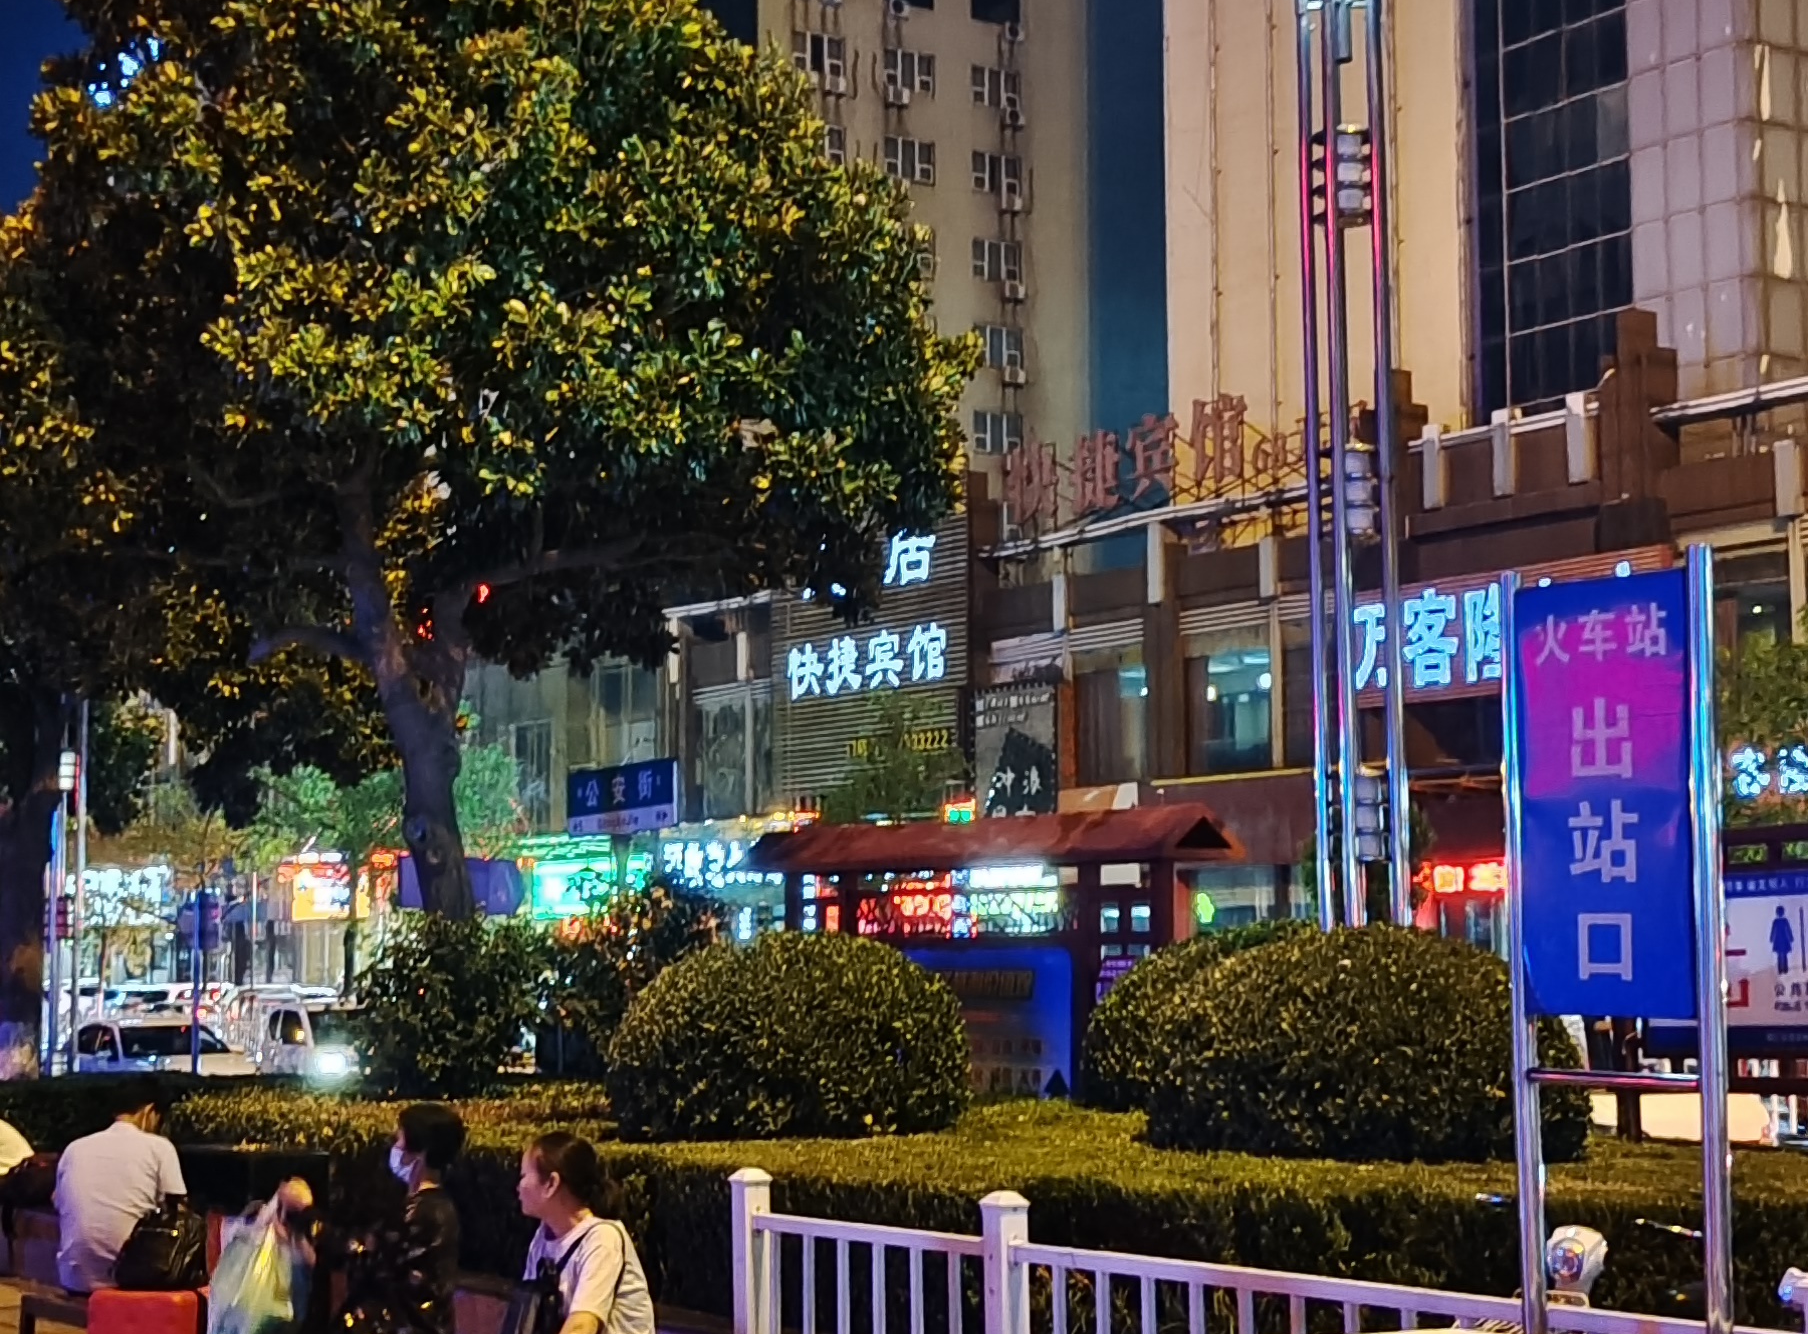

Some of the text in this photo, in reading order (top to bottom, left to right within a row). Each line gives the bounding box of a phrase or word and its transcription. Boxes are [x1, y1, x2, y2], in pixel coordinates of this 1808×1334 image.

[787, 622, 947, 701] 快捷宾馆
[1535, 602, 1668, 665] 火车站
[585, 768, 652, 807] 公安街
[1568, 697, 1639, 981] 出站口
